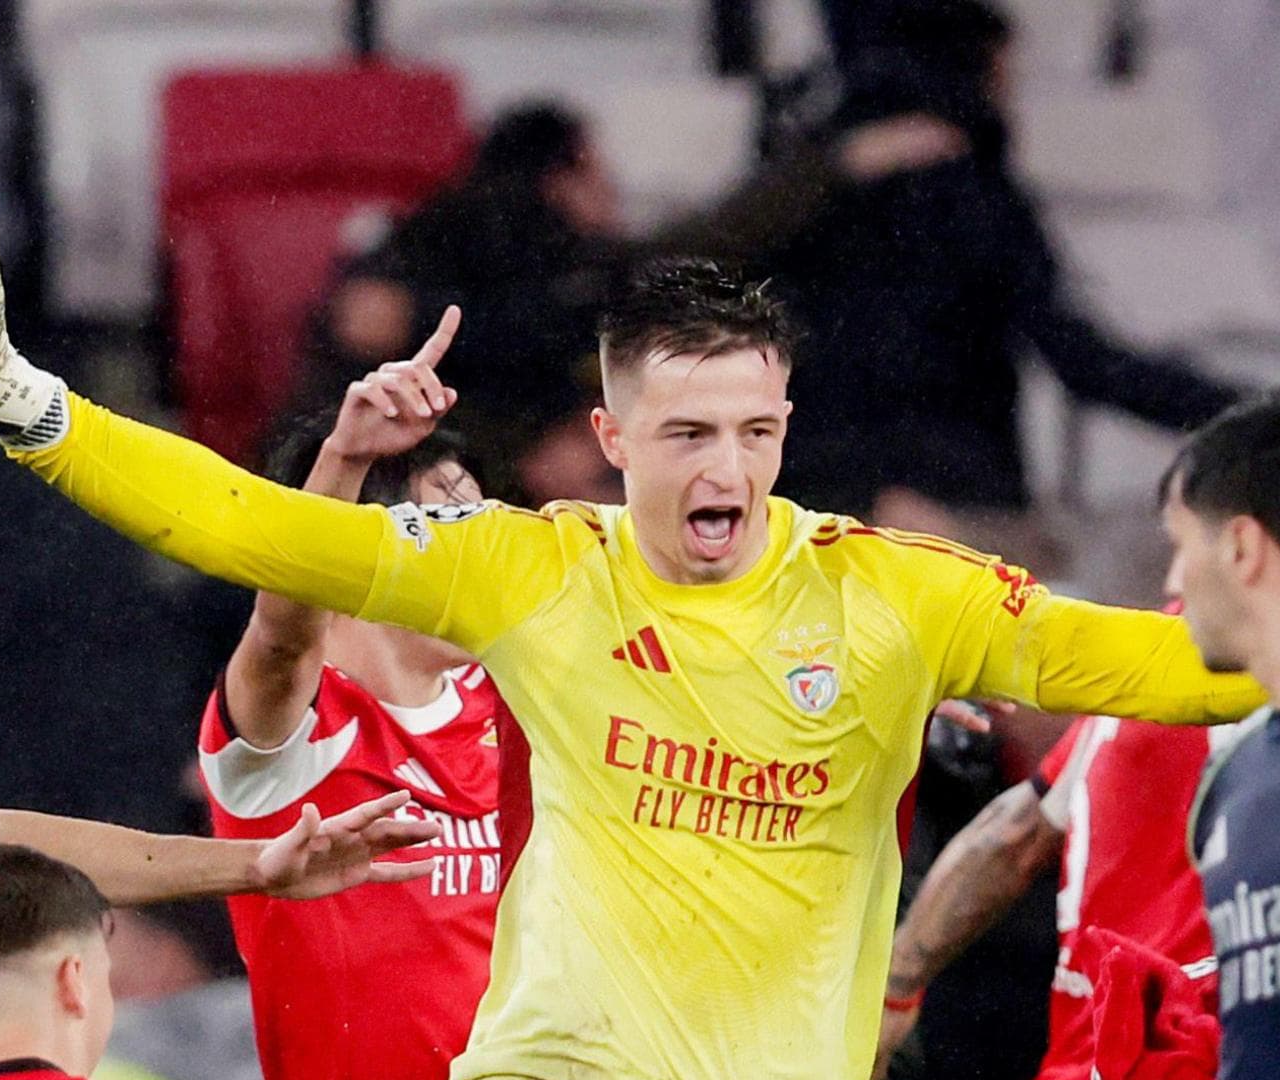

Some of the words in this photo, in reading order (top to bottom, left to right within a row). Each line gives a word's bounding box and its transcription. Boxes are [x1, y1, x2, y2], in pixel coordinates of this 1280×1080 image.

[605, 715, 830, 801] Emirates
[633, 784, 686, 830] FLY
[695, 794, 804, 842] BETTER
[431, 855, 472, 896] FLY
